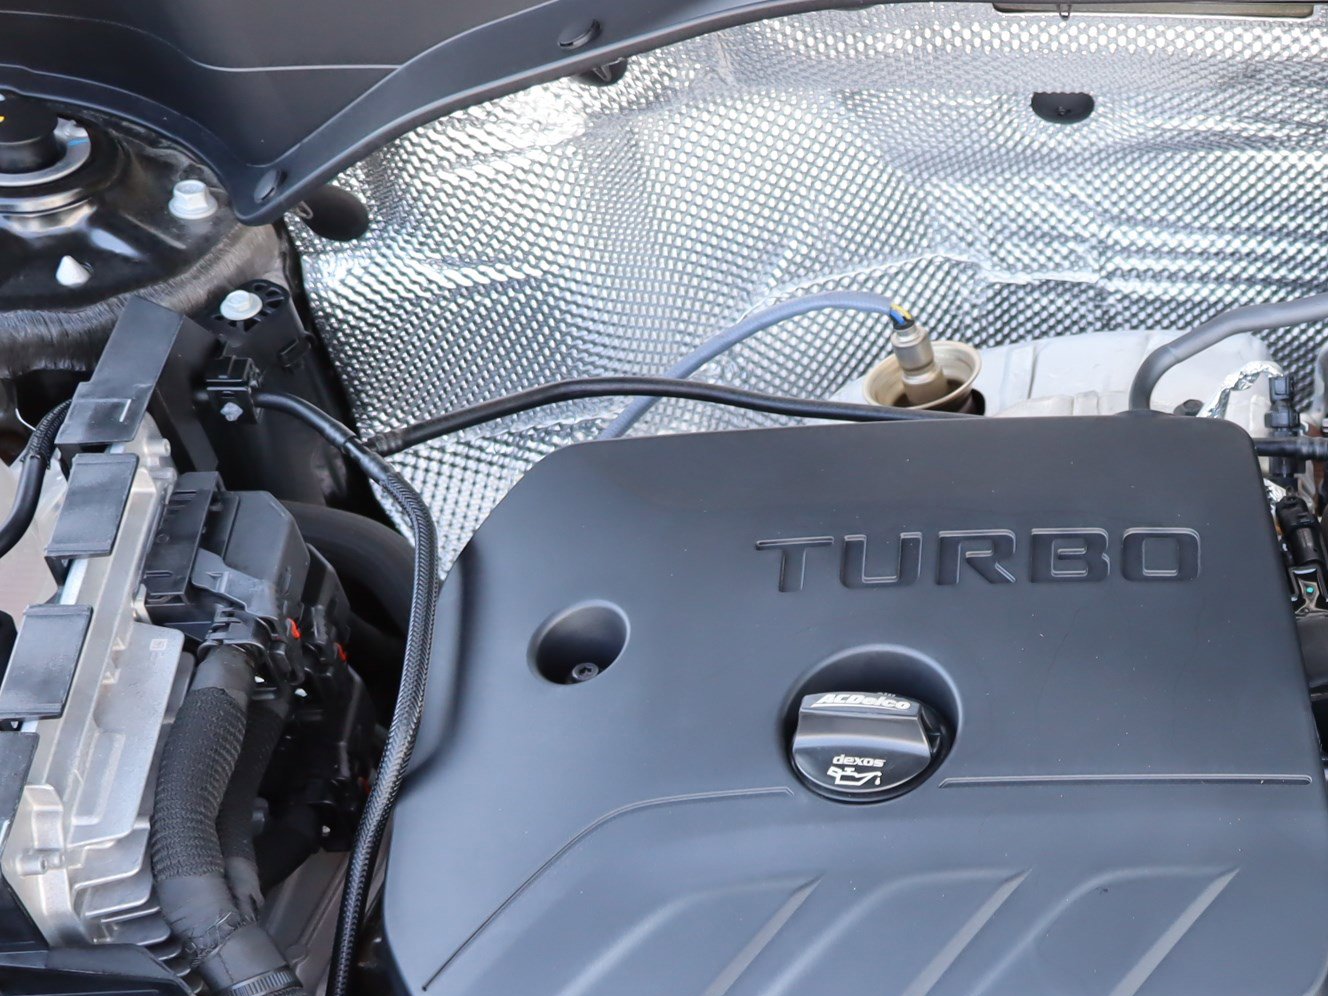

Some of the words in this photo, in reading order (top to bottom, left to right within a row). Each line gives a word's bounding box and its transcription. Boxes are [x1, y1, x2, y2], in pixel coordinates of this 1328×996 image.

[755, 527, 1201, 593] TURBO
[811, 694, 911, 710] ACDelco
[832, 754, 886, 768] dexos
